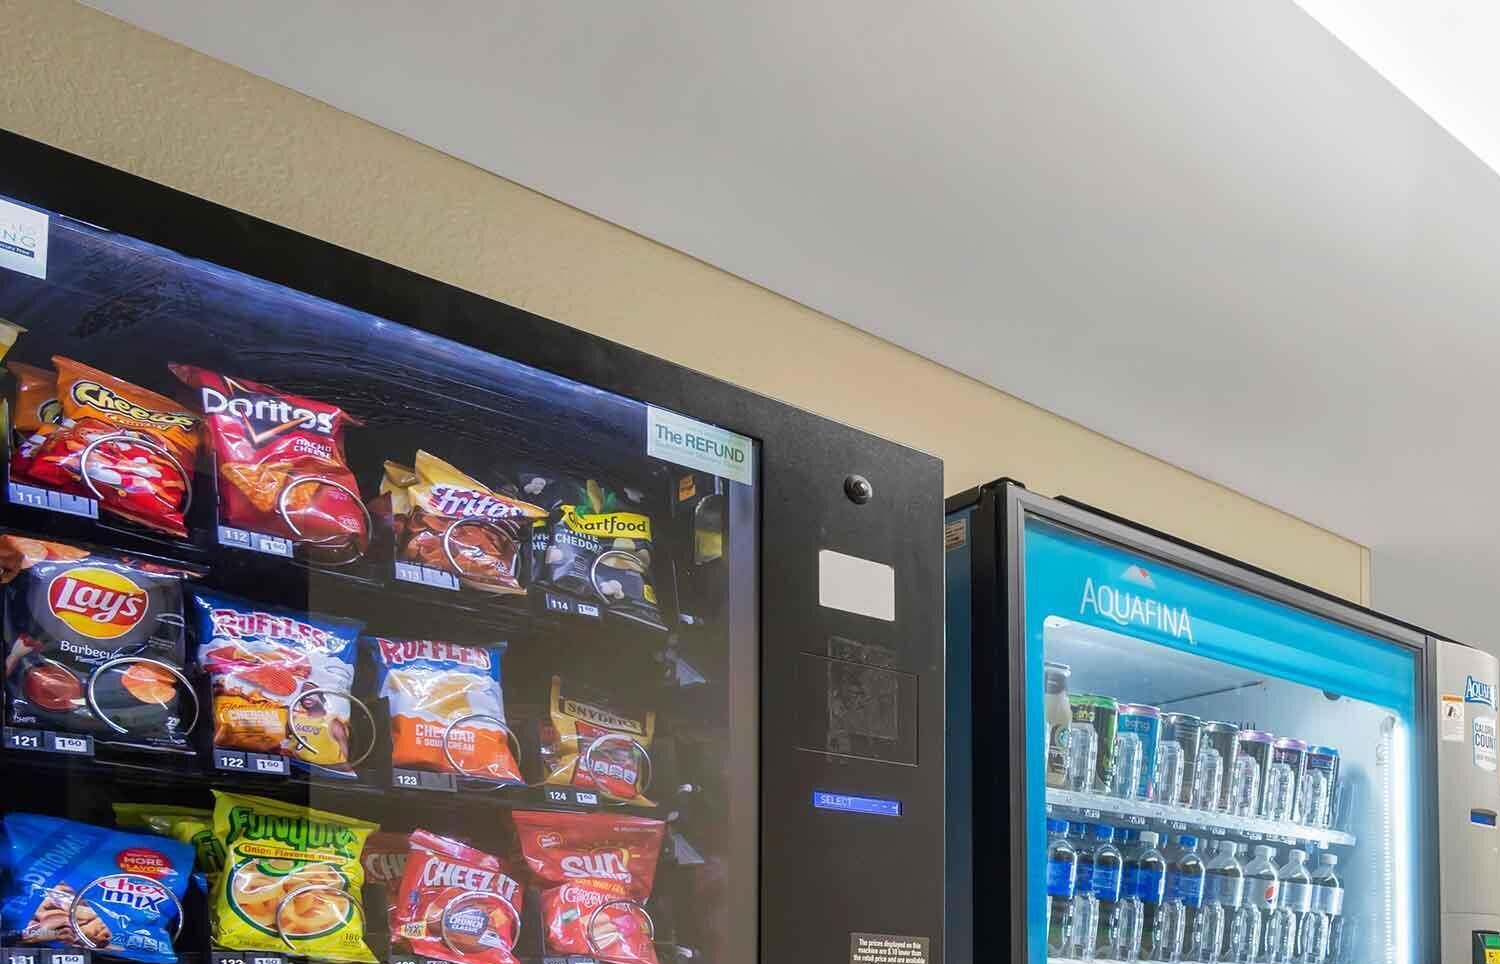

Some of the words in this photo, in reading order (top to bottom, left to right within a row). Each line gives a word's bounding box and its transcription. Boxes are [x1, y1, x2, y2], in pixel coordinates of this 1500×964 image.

[202, 387, 333, 434] Doritos
[656, 423, 682, 444] The
[685, 433, 745, 463] REFUND
[56, 578, 143, 622] Lay's
[1080, 577, 1194, 644] AQUAFINA
[212, 609, 329, 648] RUFFLES
[376, 638, 492, 669] RUFFLES
[12, 735, 38, 746] 121
[221, 757, 244, 768] 122
[397, 775, 418, 785] 123
[549, 791, 567, 801] 124
